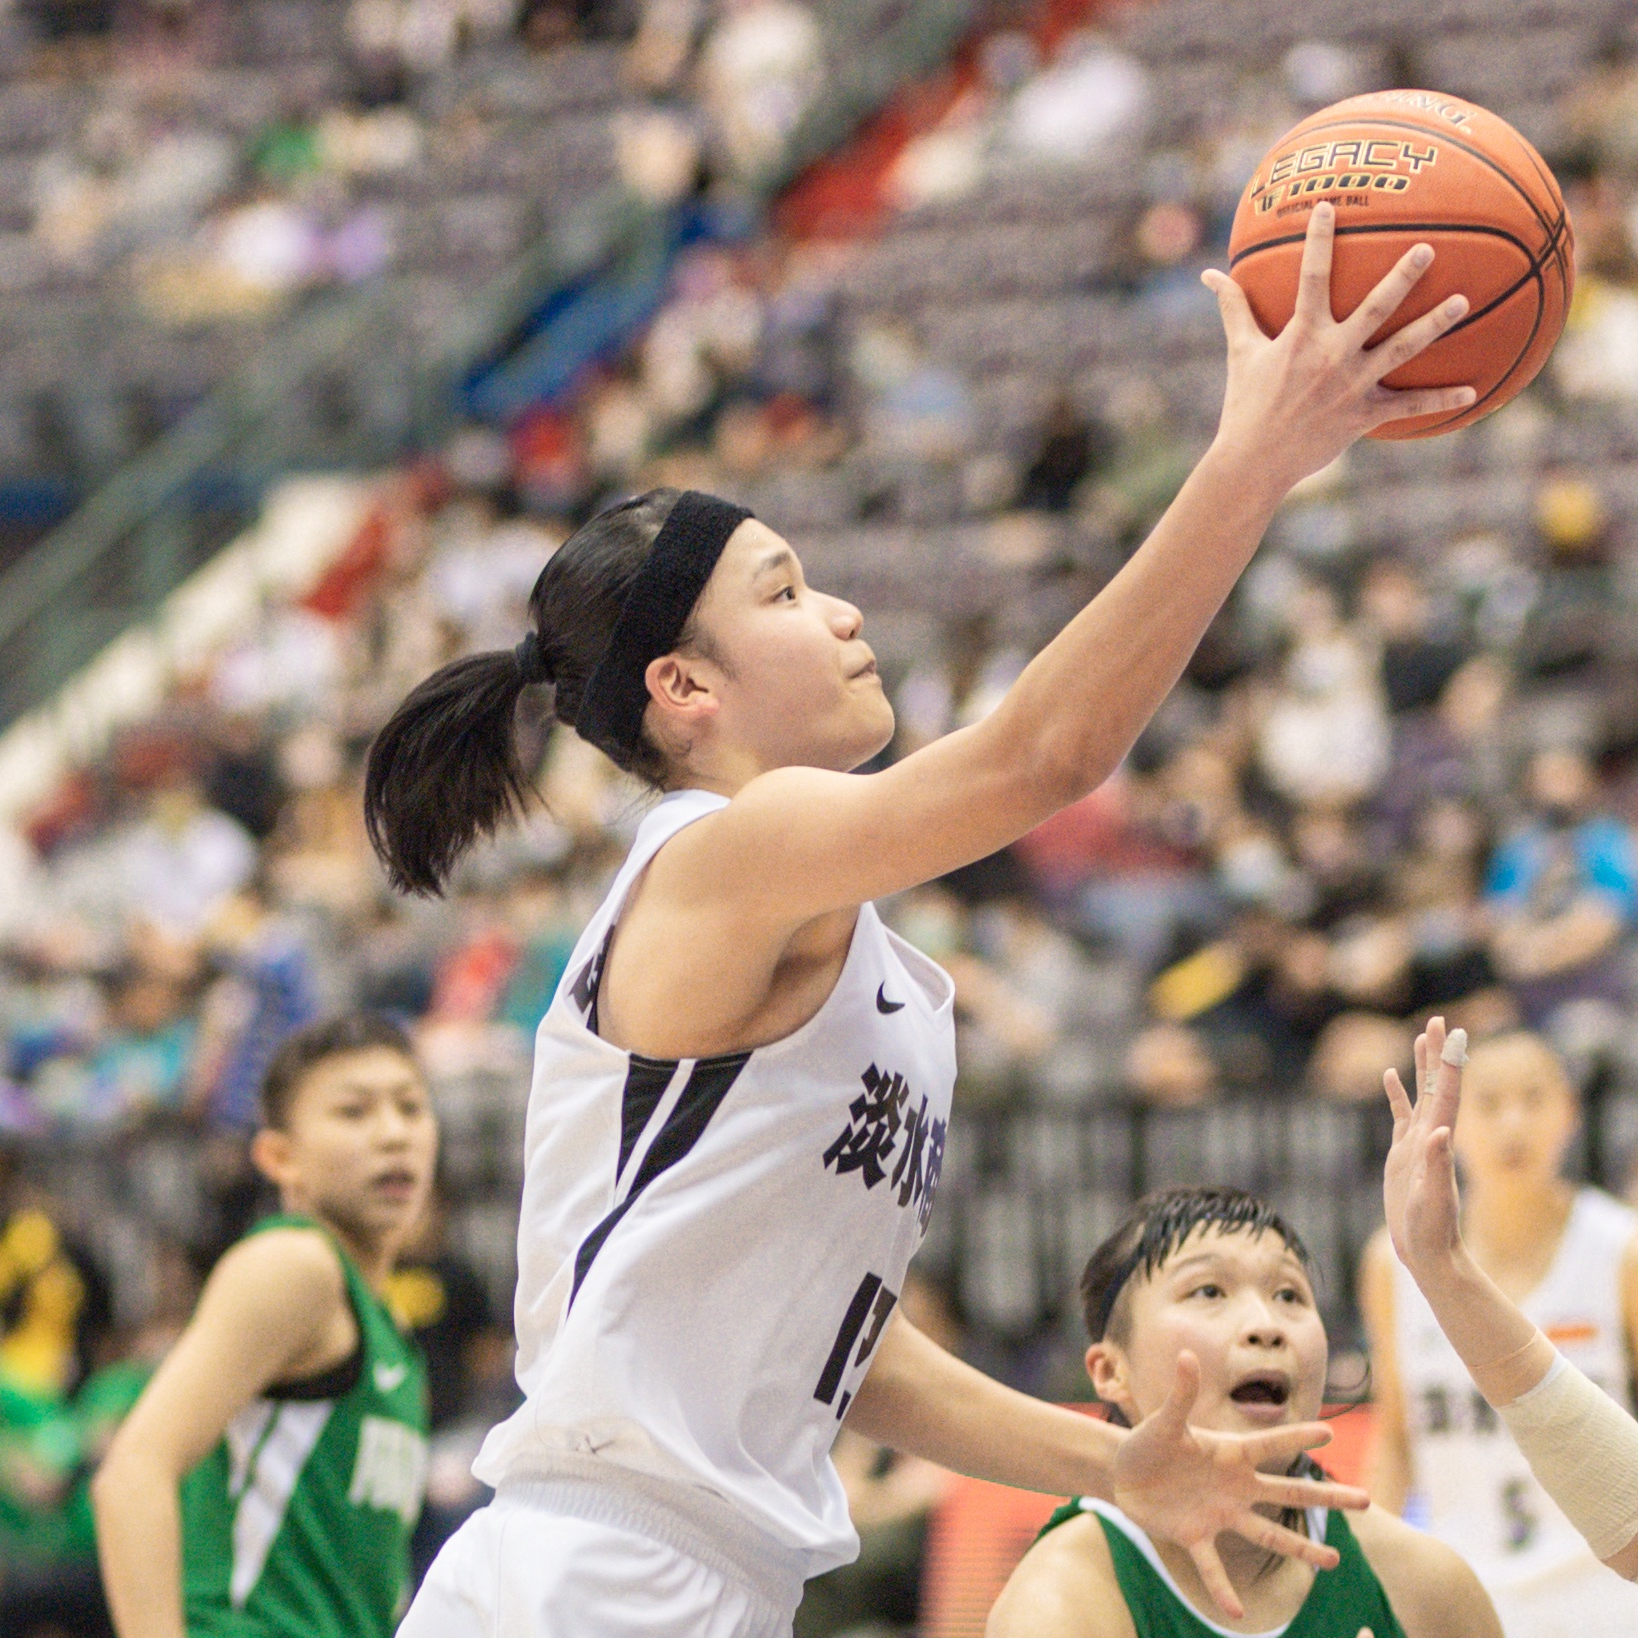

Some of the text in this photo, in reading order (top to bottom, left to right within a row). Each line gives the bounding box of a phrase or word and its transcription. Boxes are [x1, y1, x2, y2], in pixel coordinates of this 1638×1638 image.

[1249, 138, 1438, 203] LEGACY
[1276, 199, 1313, 219] OFFICIAL
[1346, 195, 1369, 207] BALL
